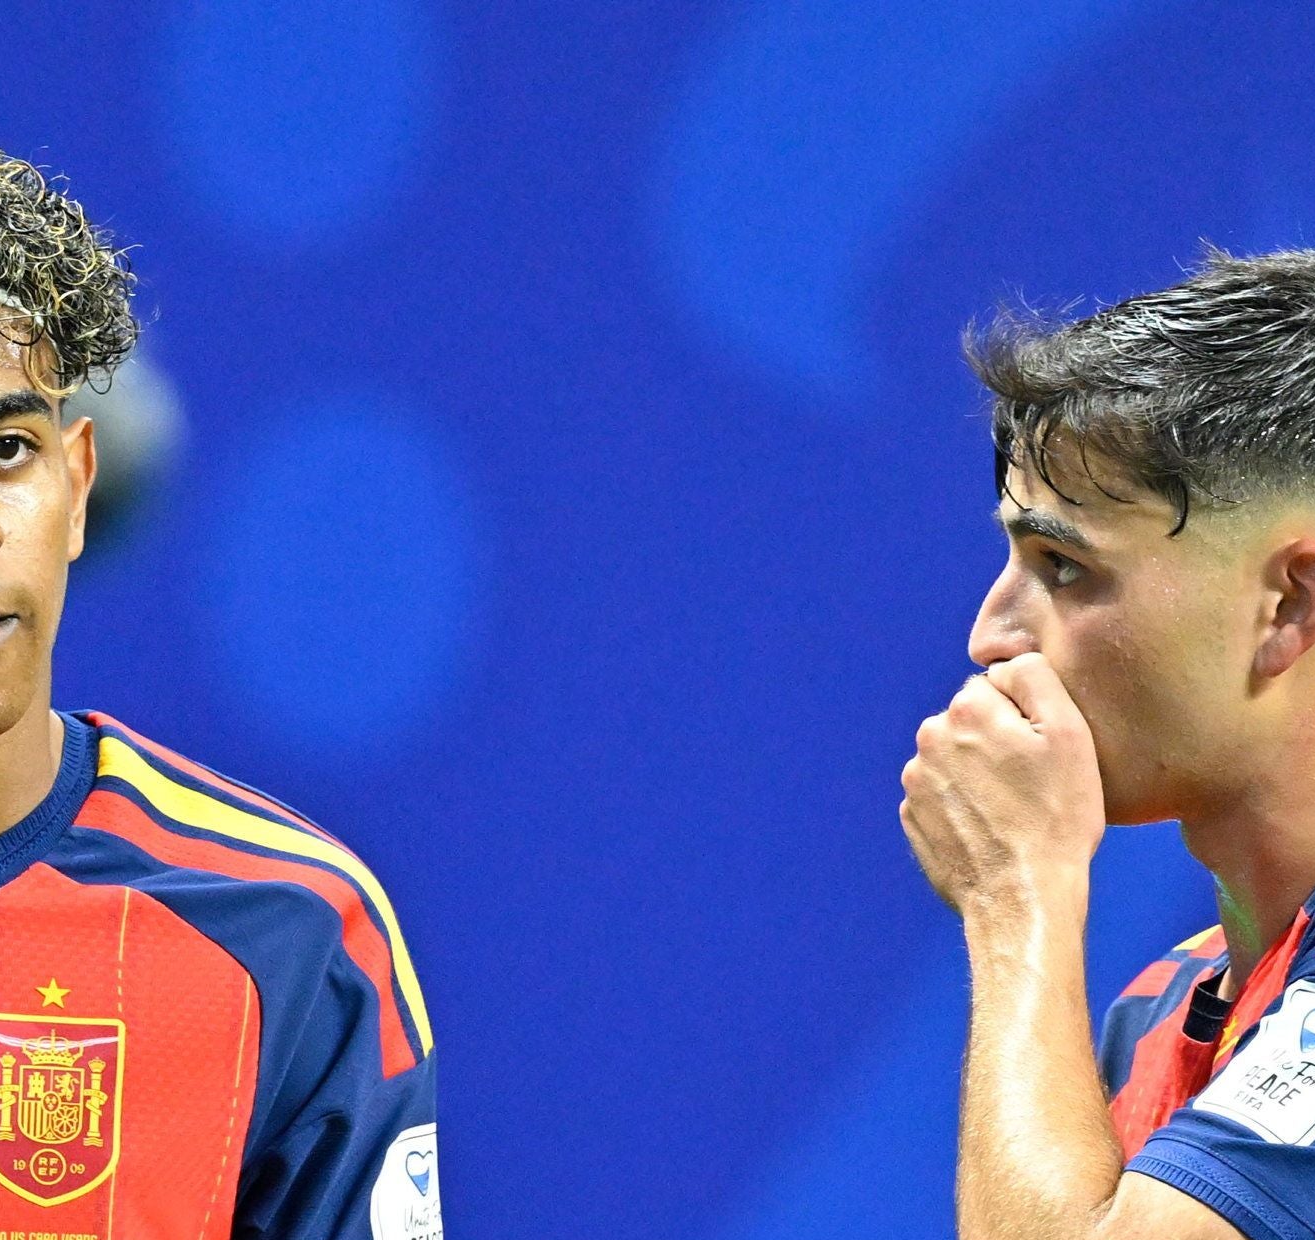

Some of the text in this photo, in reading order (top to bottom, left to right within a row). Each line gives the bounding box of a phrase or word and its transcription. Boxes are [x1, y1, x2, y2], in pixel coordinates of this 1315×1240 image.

[1240, 1065, 1301, 1106] PEACE
[1234, 1090, 1263, 1110] FIFA
[13, 1159, 26, 1170] 19
[69, 1163, 85, 1174] 09
